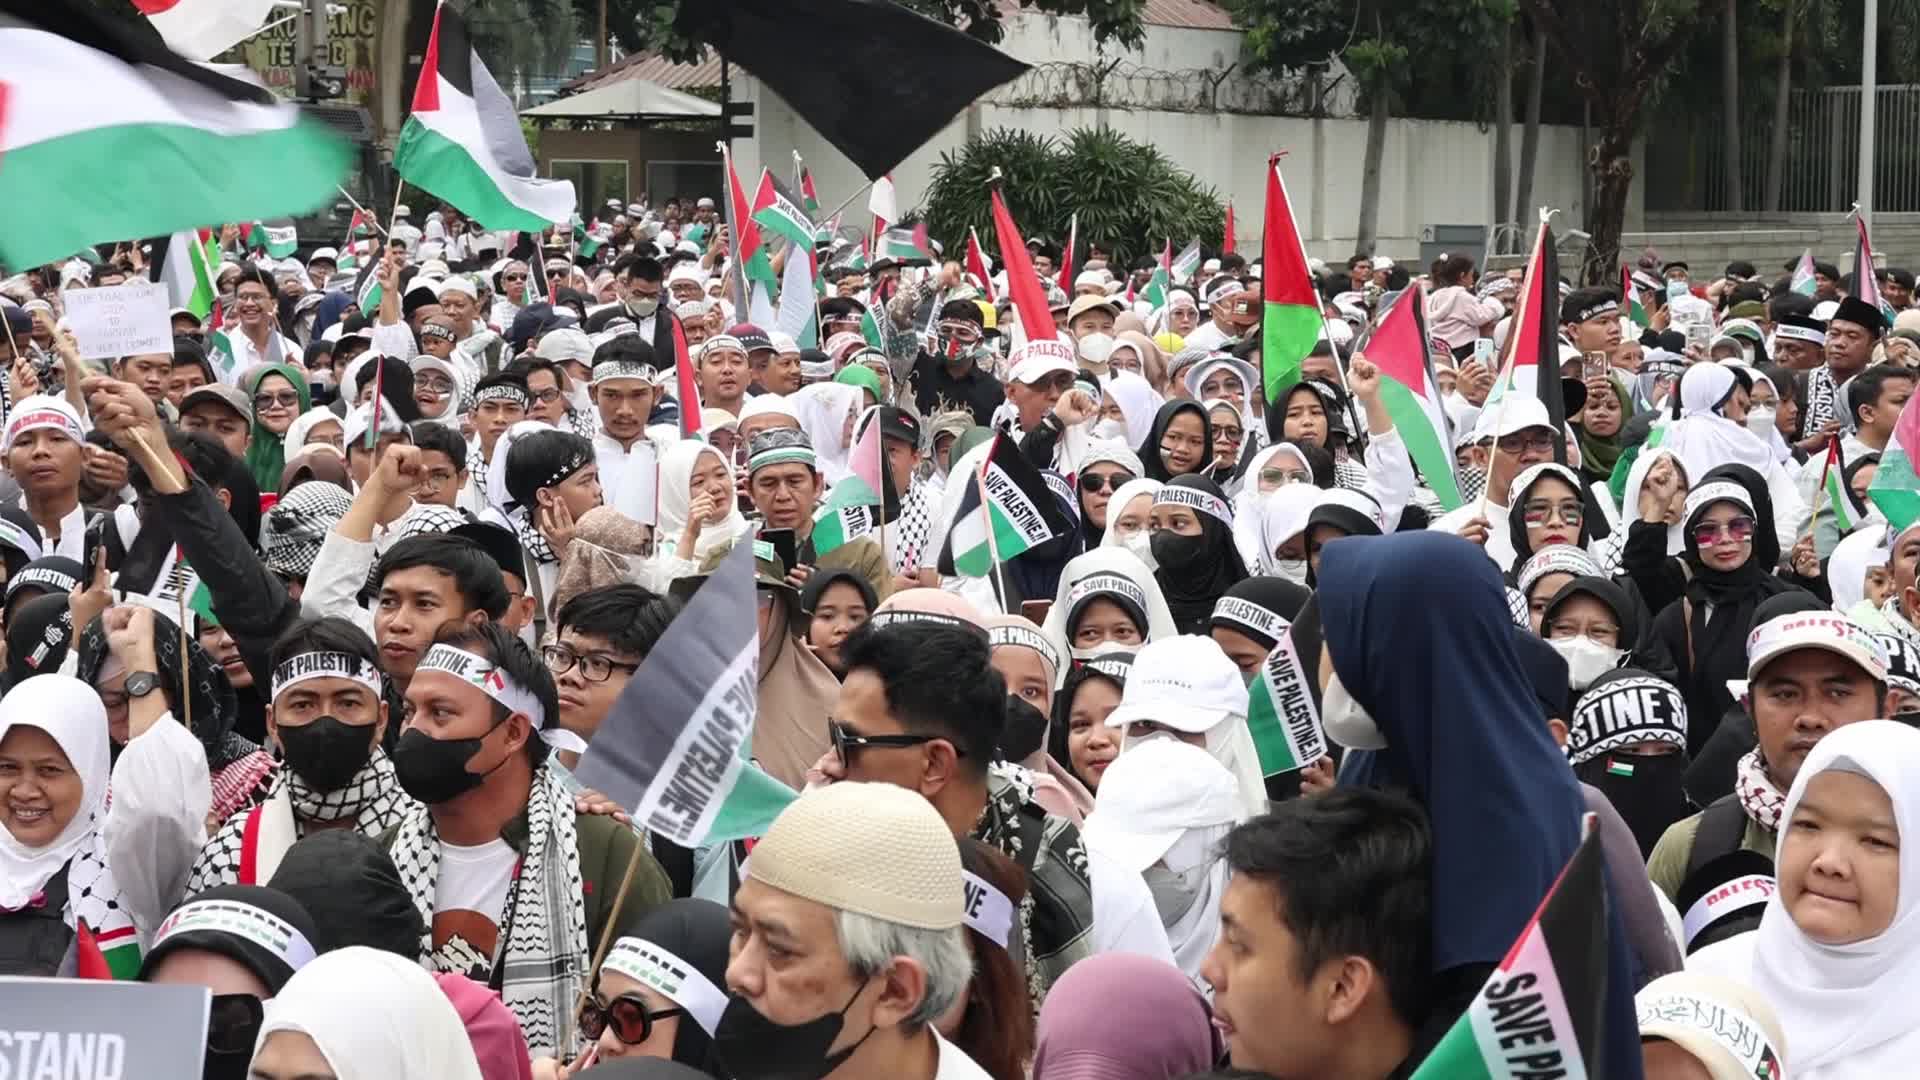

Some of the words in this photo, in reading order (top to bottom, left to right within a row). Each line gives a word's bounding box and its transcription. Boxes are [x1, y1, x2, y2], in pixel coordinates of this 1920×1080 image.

[985, 470, 1007, 498] SAVE
[1159, 489, 1205, 508] PALESTINE
[1083, 578, 1110, 593] SAVE
[1221, 598, 1277, 631] PALESTINE
[1268, 649, 1297, 687] SAVE
[1568, 687, 1664, 748] STINE
[1484, 971, 1557, 1051] SAVE
